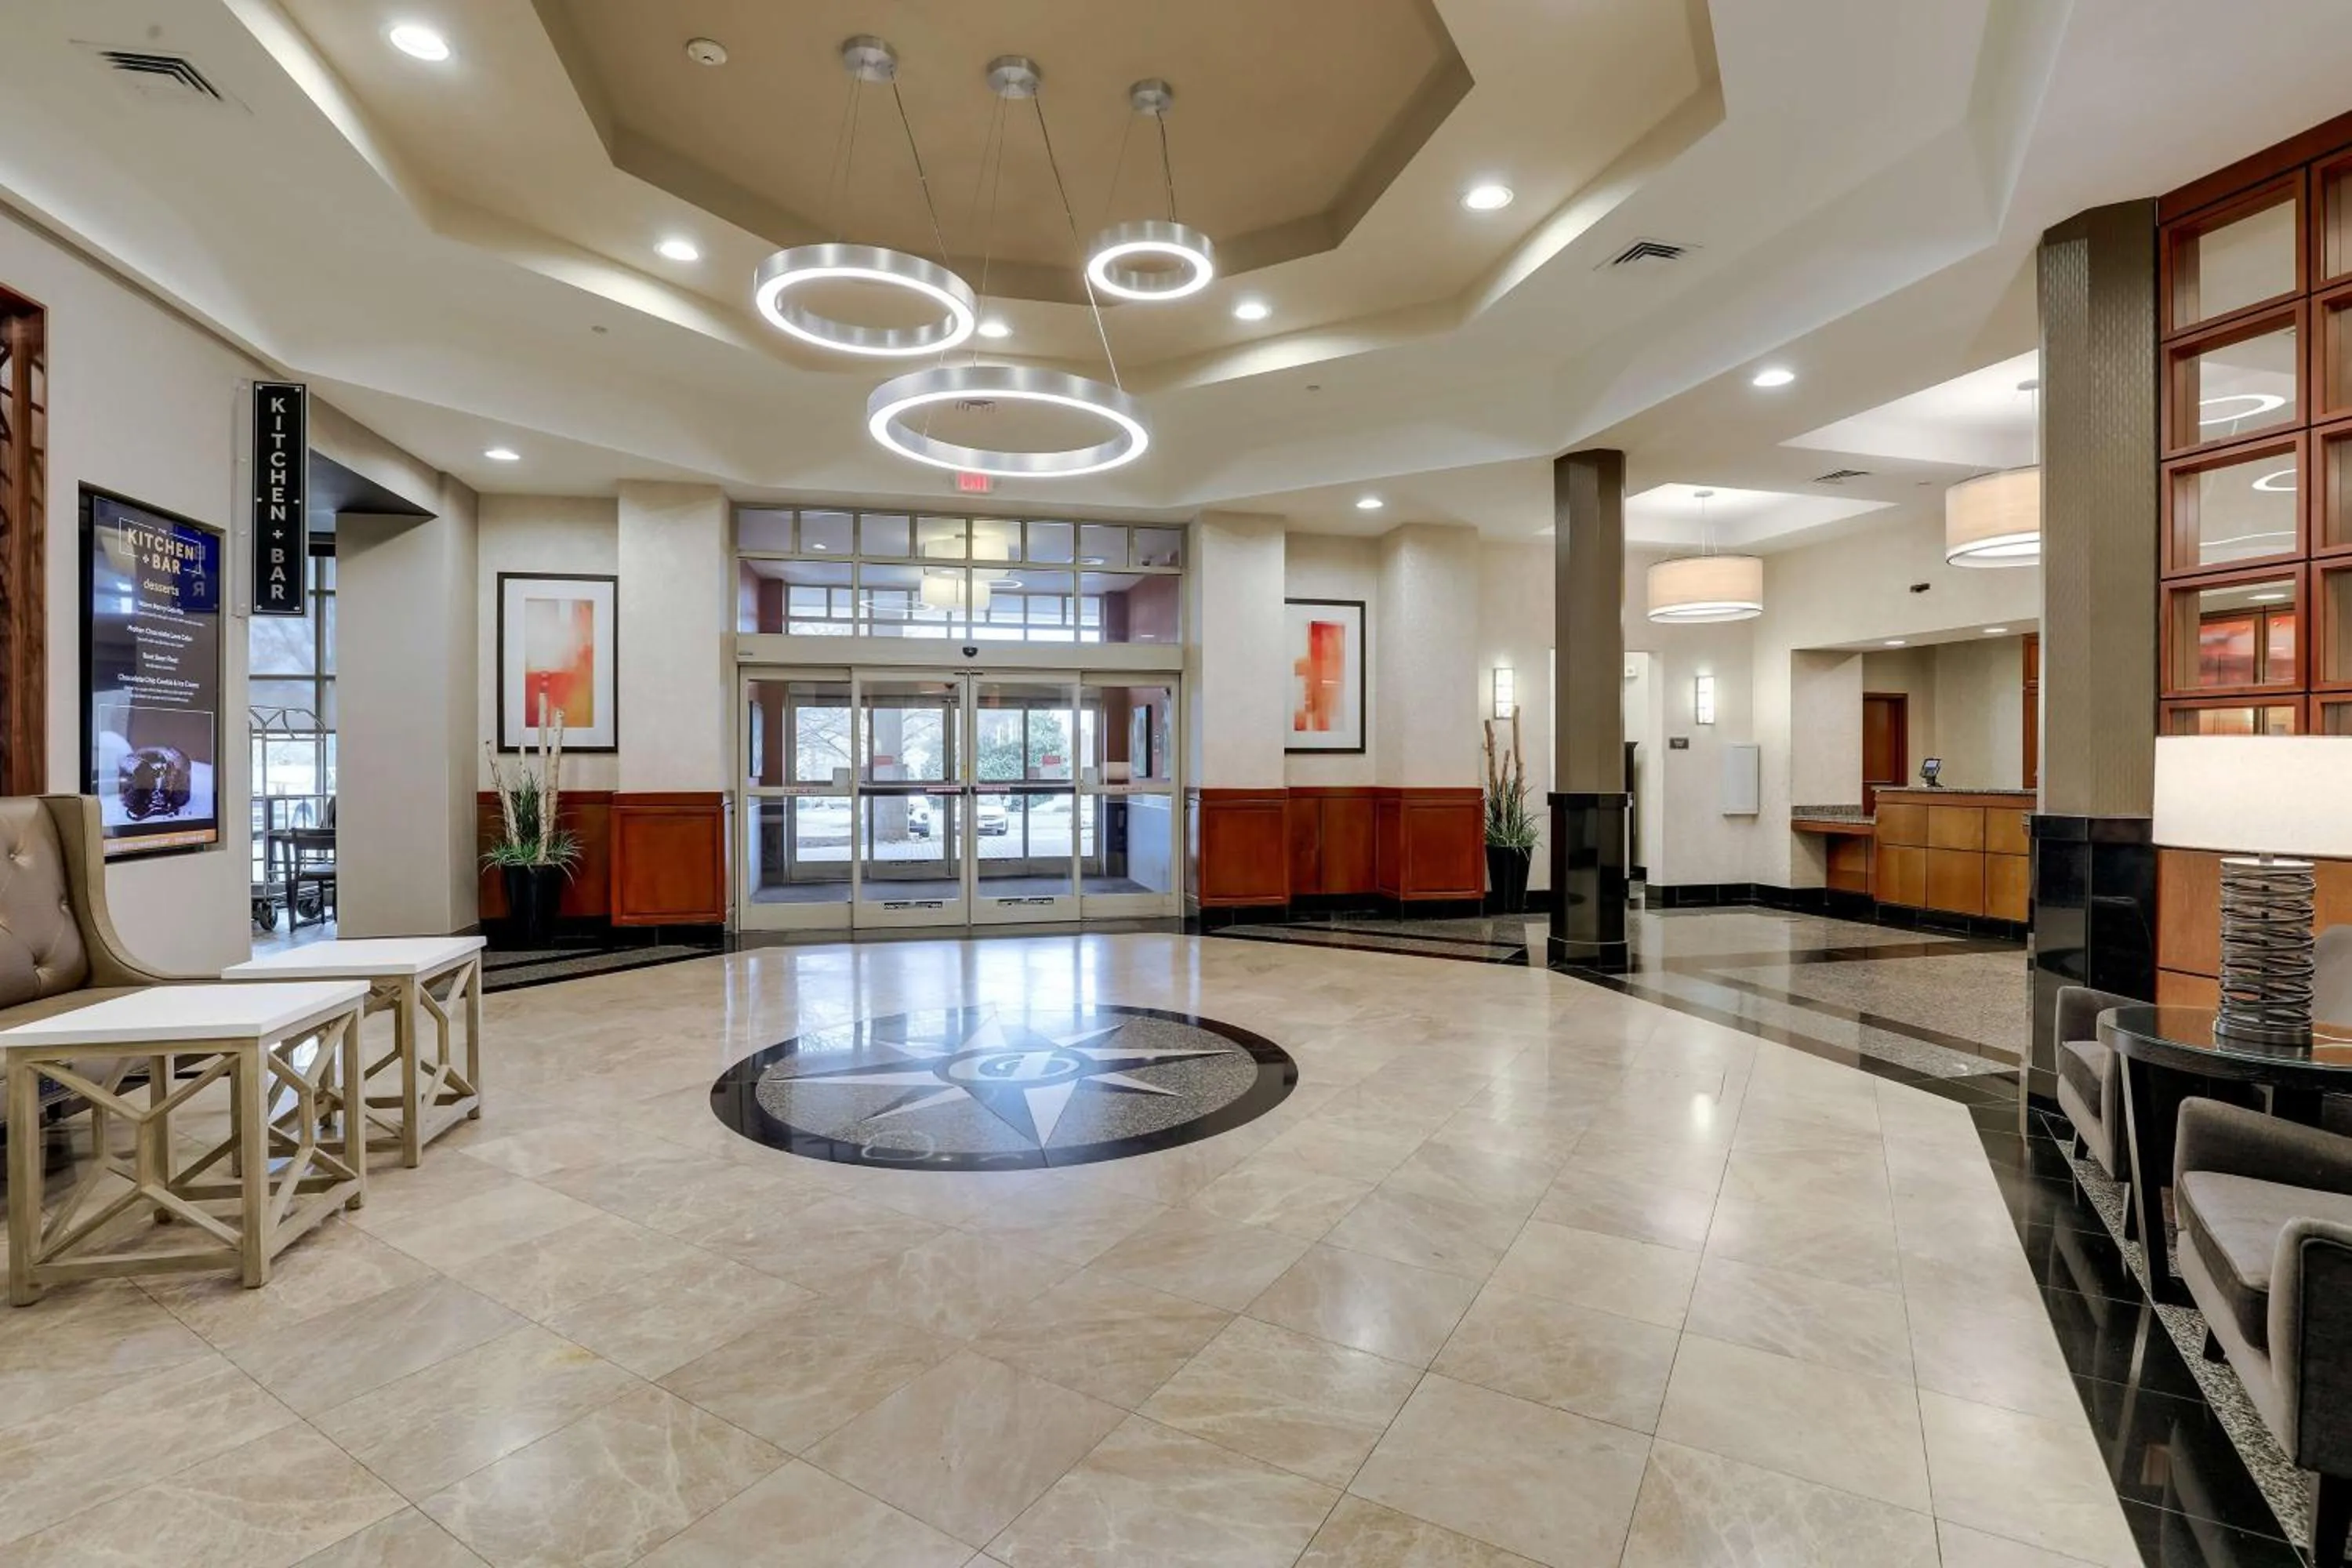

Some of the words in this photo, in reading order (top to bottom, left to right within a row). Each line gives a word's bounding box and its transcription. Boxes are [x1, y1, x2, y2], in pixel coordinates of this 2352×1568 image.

[270, 397, 286, 521] KITCHEN
[127, 528, 194, 561] KITCHEN
[152, 554, 181, 575] BAR
[270, 547, 286, 600] BAR
[143, 578, 180, 597] desserts
